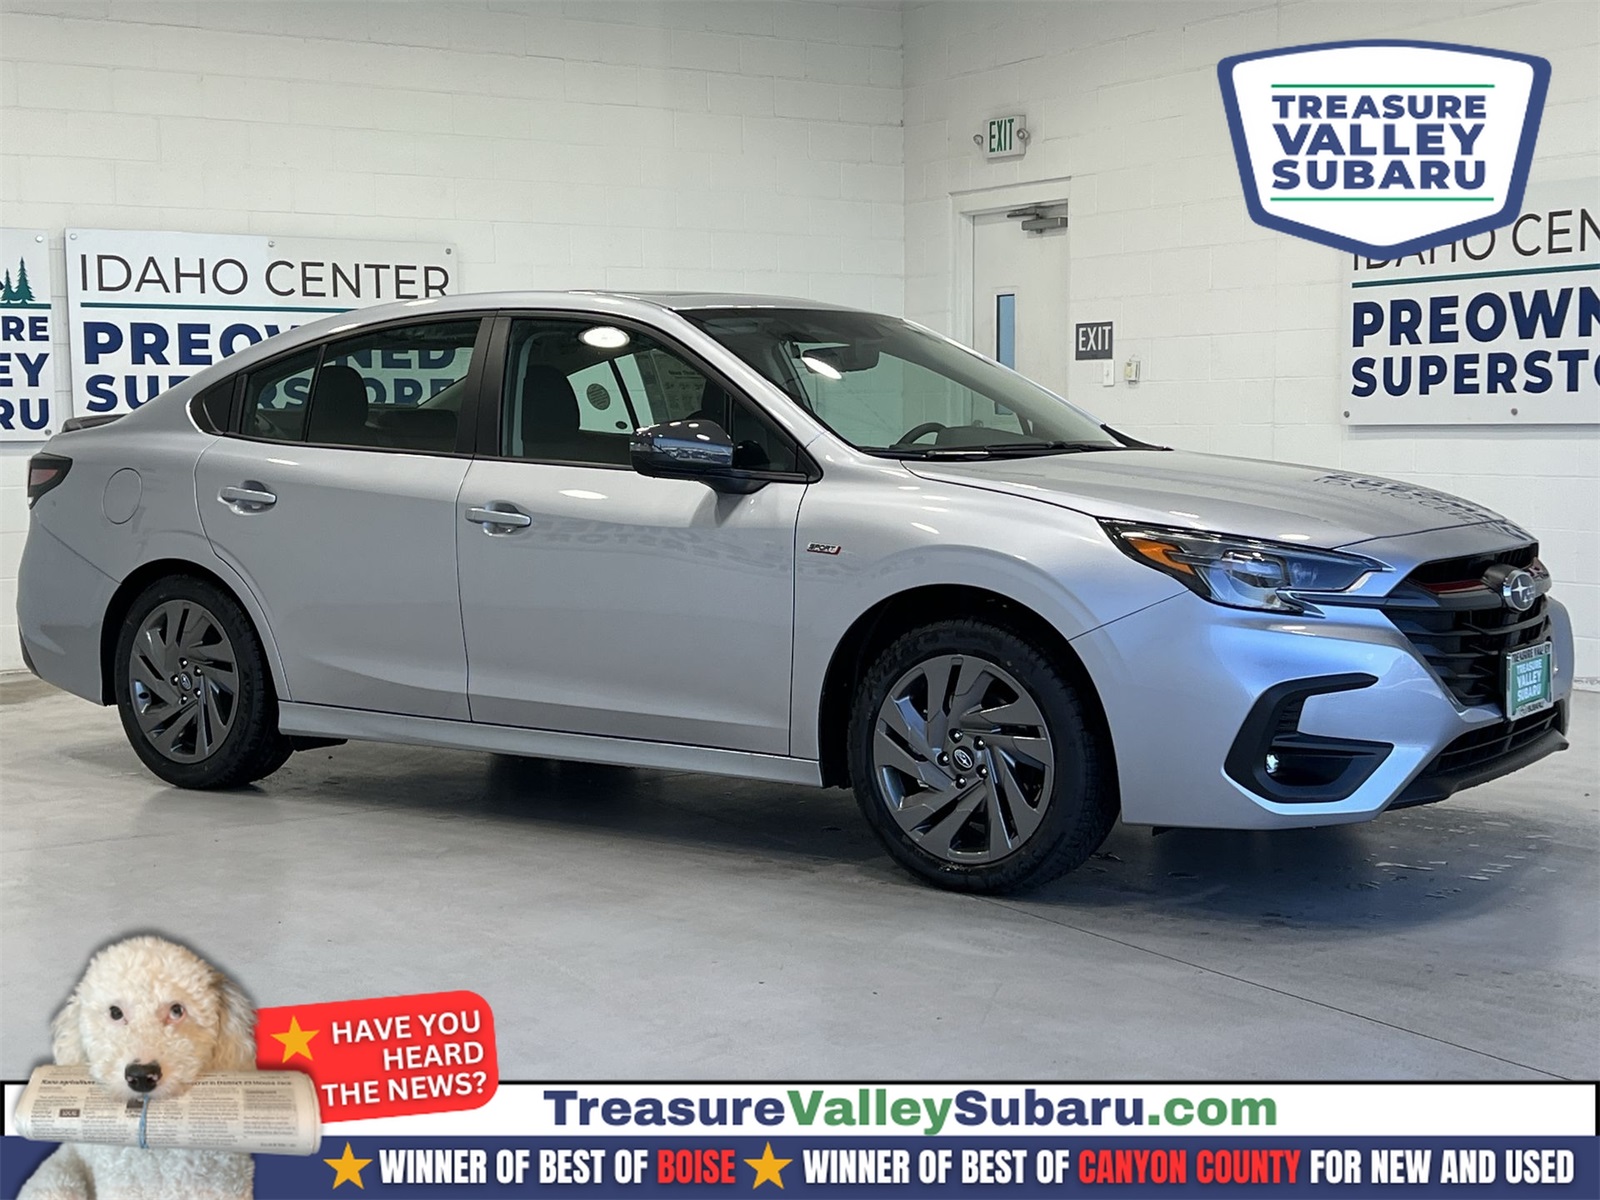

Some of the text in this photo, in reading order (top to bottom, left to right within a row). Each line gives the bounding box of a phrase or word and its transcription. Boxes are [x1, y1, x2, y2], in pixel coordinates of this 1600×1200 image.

[989, 118, 1015, 153] EXIT
[80, 253, 450, 299] IDAHO CENTER
[1078, 326, 1112, 352] EXIT
[1351, 349, 1600, 397] SUPERST
[808, 542, 837, 552] SPORT
[1516, 658, 1542, 675] TREASURE
[1517, 669, 1542, 688] VALLEY
[1517, 683, 1541, 702] SUBARU
